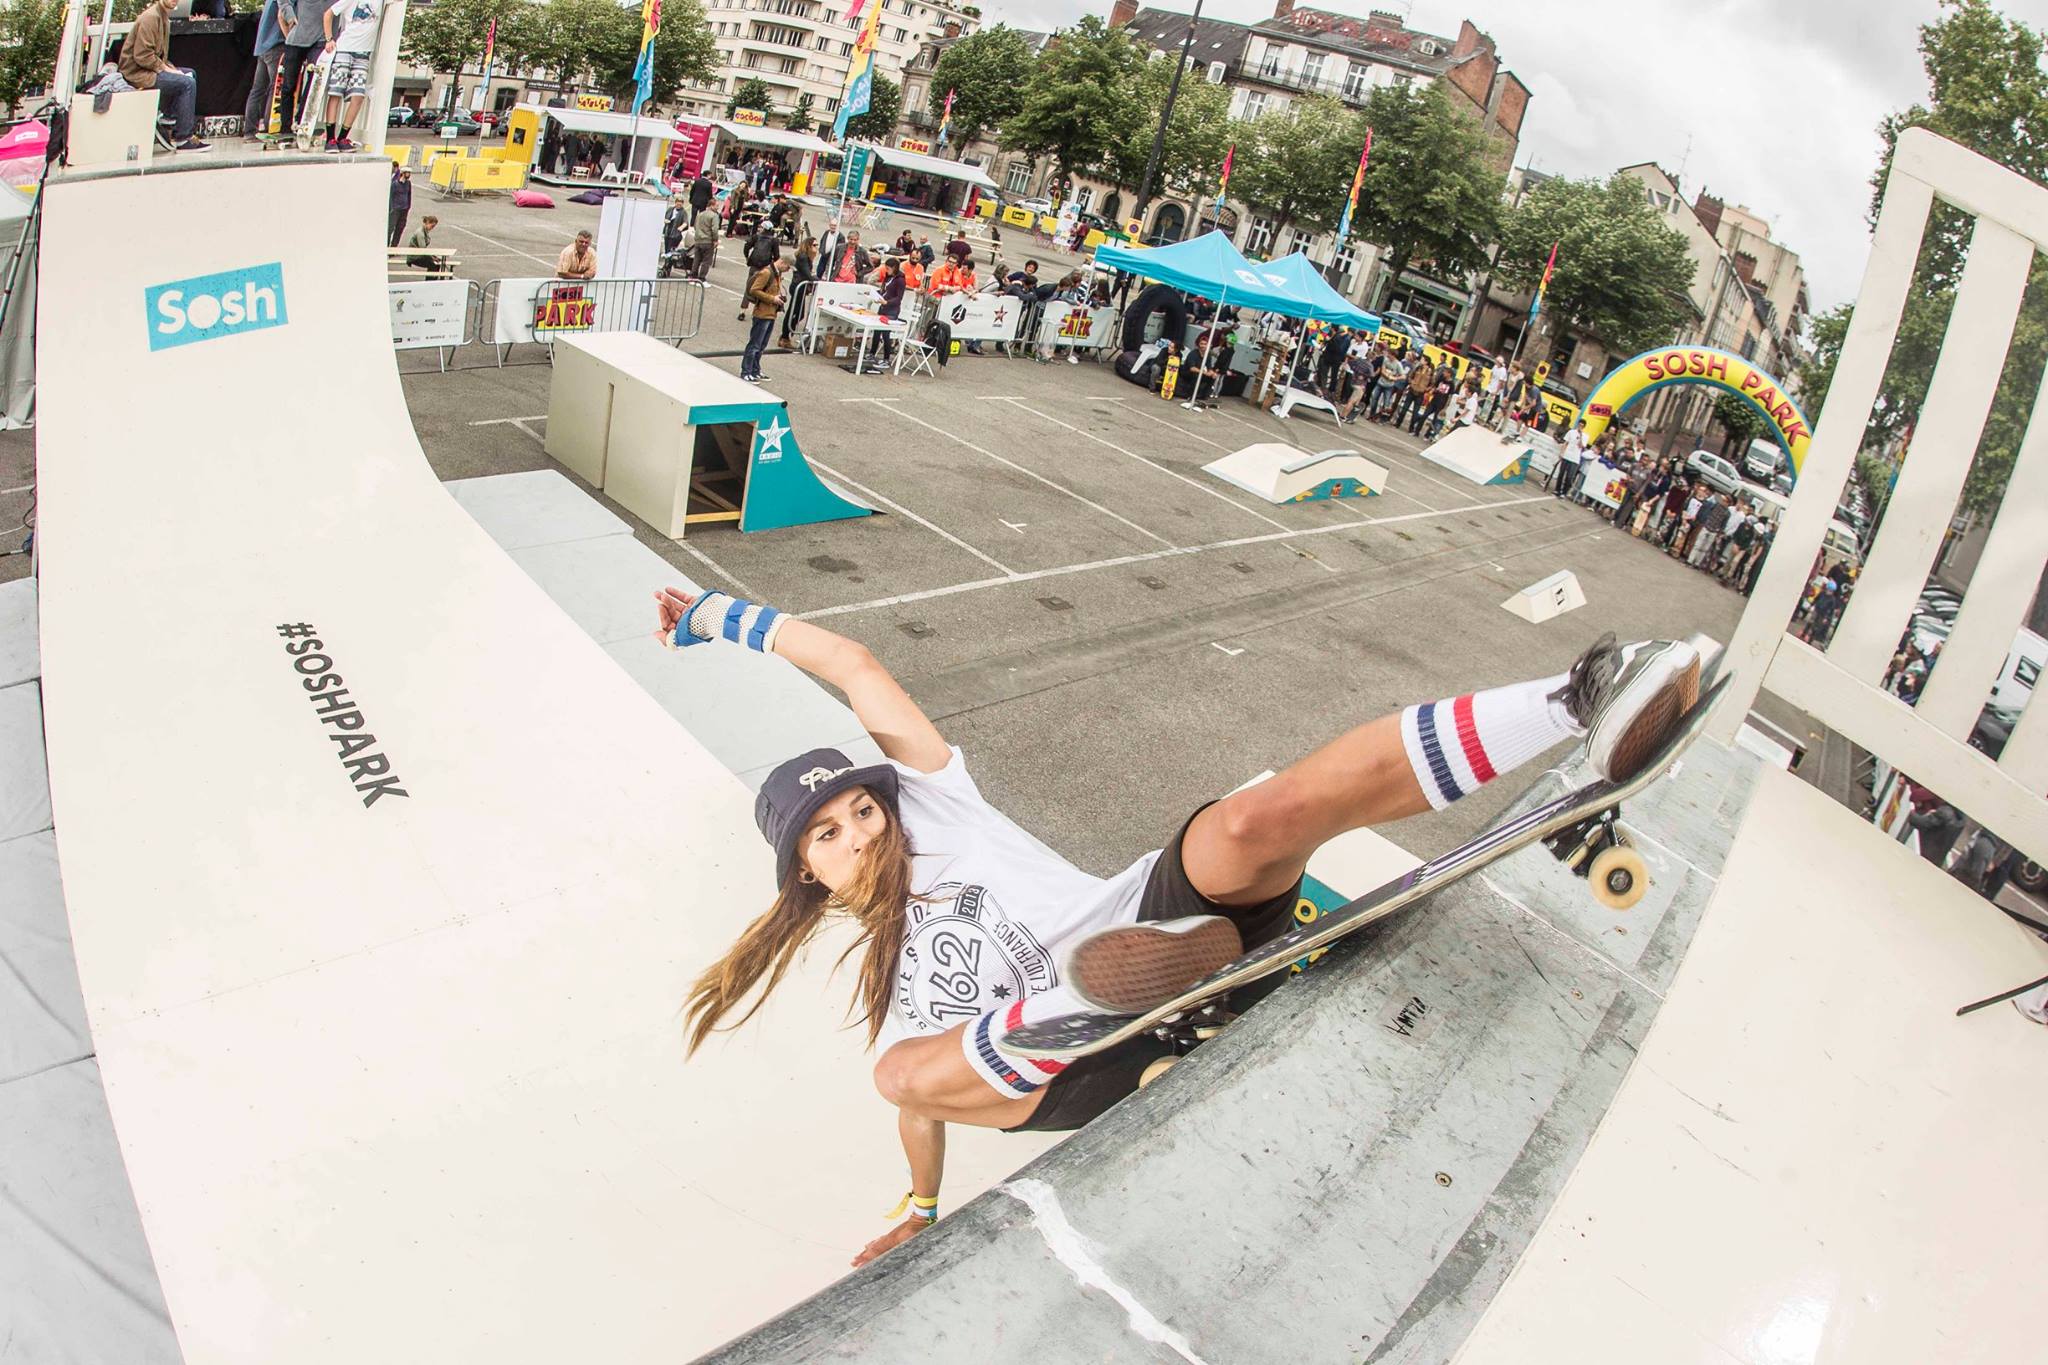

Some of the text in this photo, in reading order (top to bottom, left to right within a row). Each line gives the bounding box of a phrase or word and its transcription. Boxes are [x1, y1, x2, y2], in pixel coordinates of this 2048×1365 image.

[901, 140, 928, 153] STORE
[158, 281, 278, 334] Sosh
[535, 303, 597, 328] PARK
[1590, 404, 1612, 416] Sosh
[1644, 351, 1811, 447] SOSH PARK
[276, 622, 410, 809] #SOSHPARK
[962, 886, 981, 916] 2013
[993, 920, 1030, 966] FRANCE
[929, 931, 983, 1022] 162
